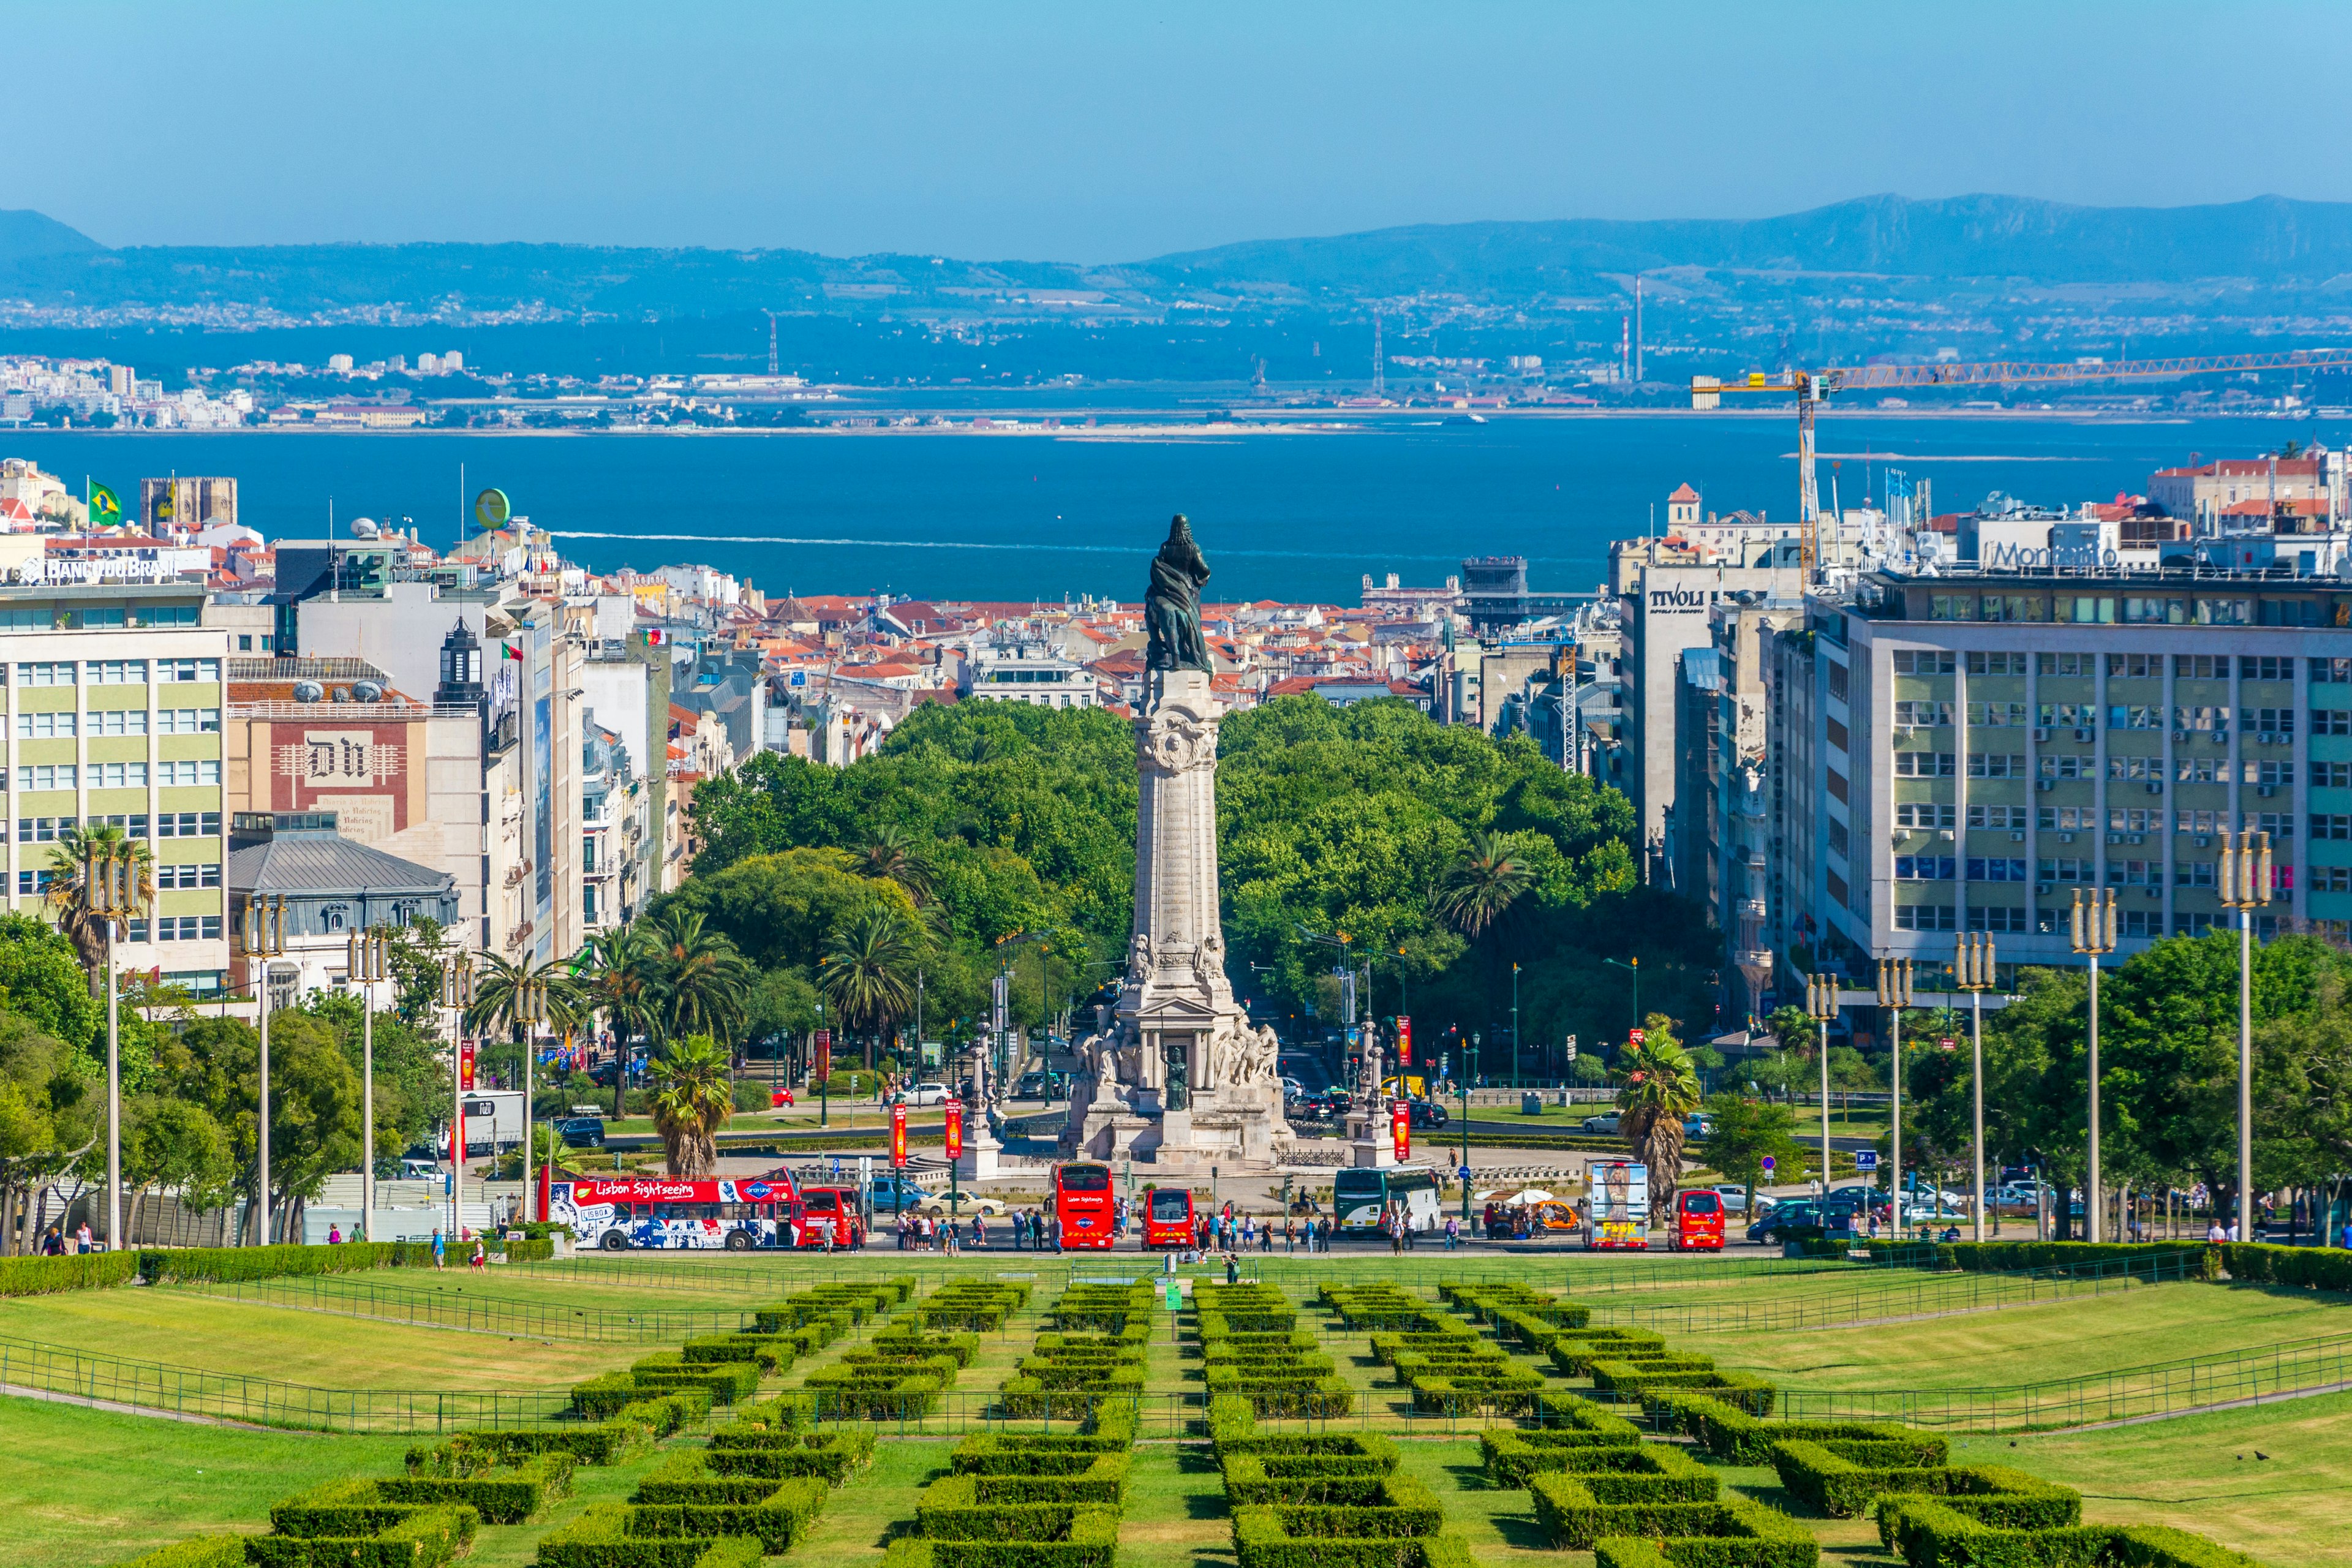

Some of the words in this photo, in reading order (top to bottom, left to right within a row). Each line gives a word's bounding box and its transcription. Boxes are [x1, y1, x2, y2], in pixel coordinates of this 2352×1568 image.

[48, 559, 104, 578] BANCO
[127, 558, 182, 577] BRASIL
[1649, 581, 1705, 606] TIVOLI
[1774, 669, 1783, 726] HOTEL
[1775, 837, 1783, 855] DE
[596, 1182, 630, 1196] Lisbon
[633, 1182, 694, 1198] Sightseeing
[583, 1209, 608, 1219] LISBOA
